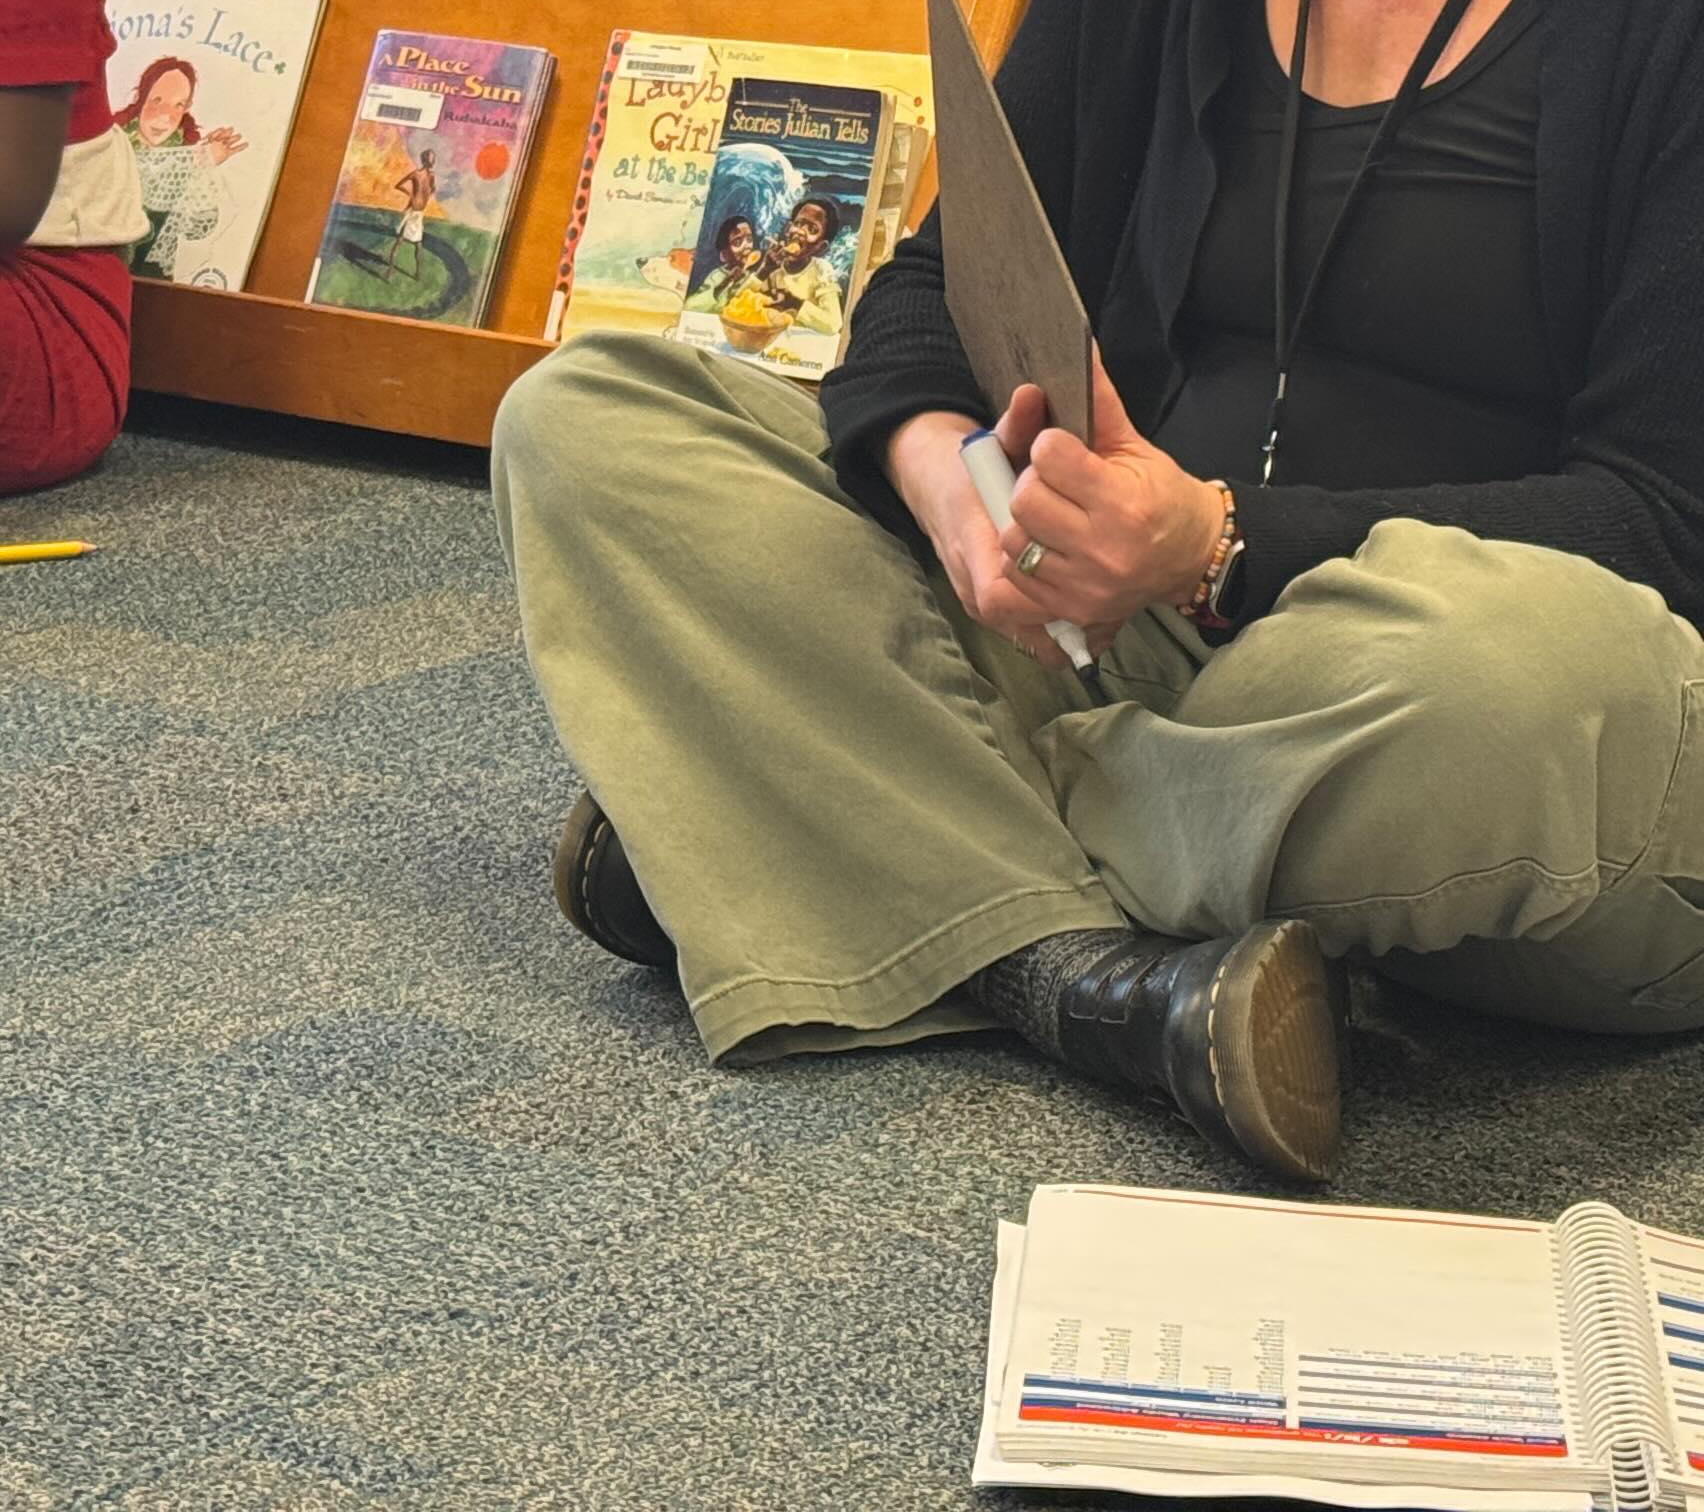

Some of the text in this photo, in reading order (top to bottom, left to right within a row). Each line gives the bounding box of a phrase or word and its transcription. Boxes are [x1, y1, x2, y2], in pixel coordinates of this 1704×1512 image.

[111, 4, 273, 73] iona's Lace
[397, 46, 470, 74] Place
[411, 75, 521, 104] in the Sun
[625, 71, 726, 110] Ladyb
[789, 98, 808, 113] The
[650, 112, 720, 154] Girl
[730, 109, 869, 144] Stories Julian Tells
[613, 155, 640, 179] at
[647, 156, 676, 183] the
